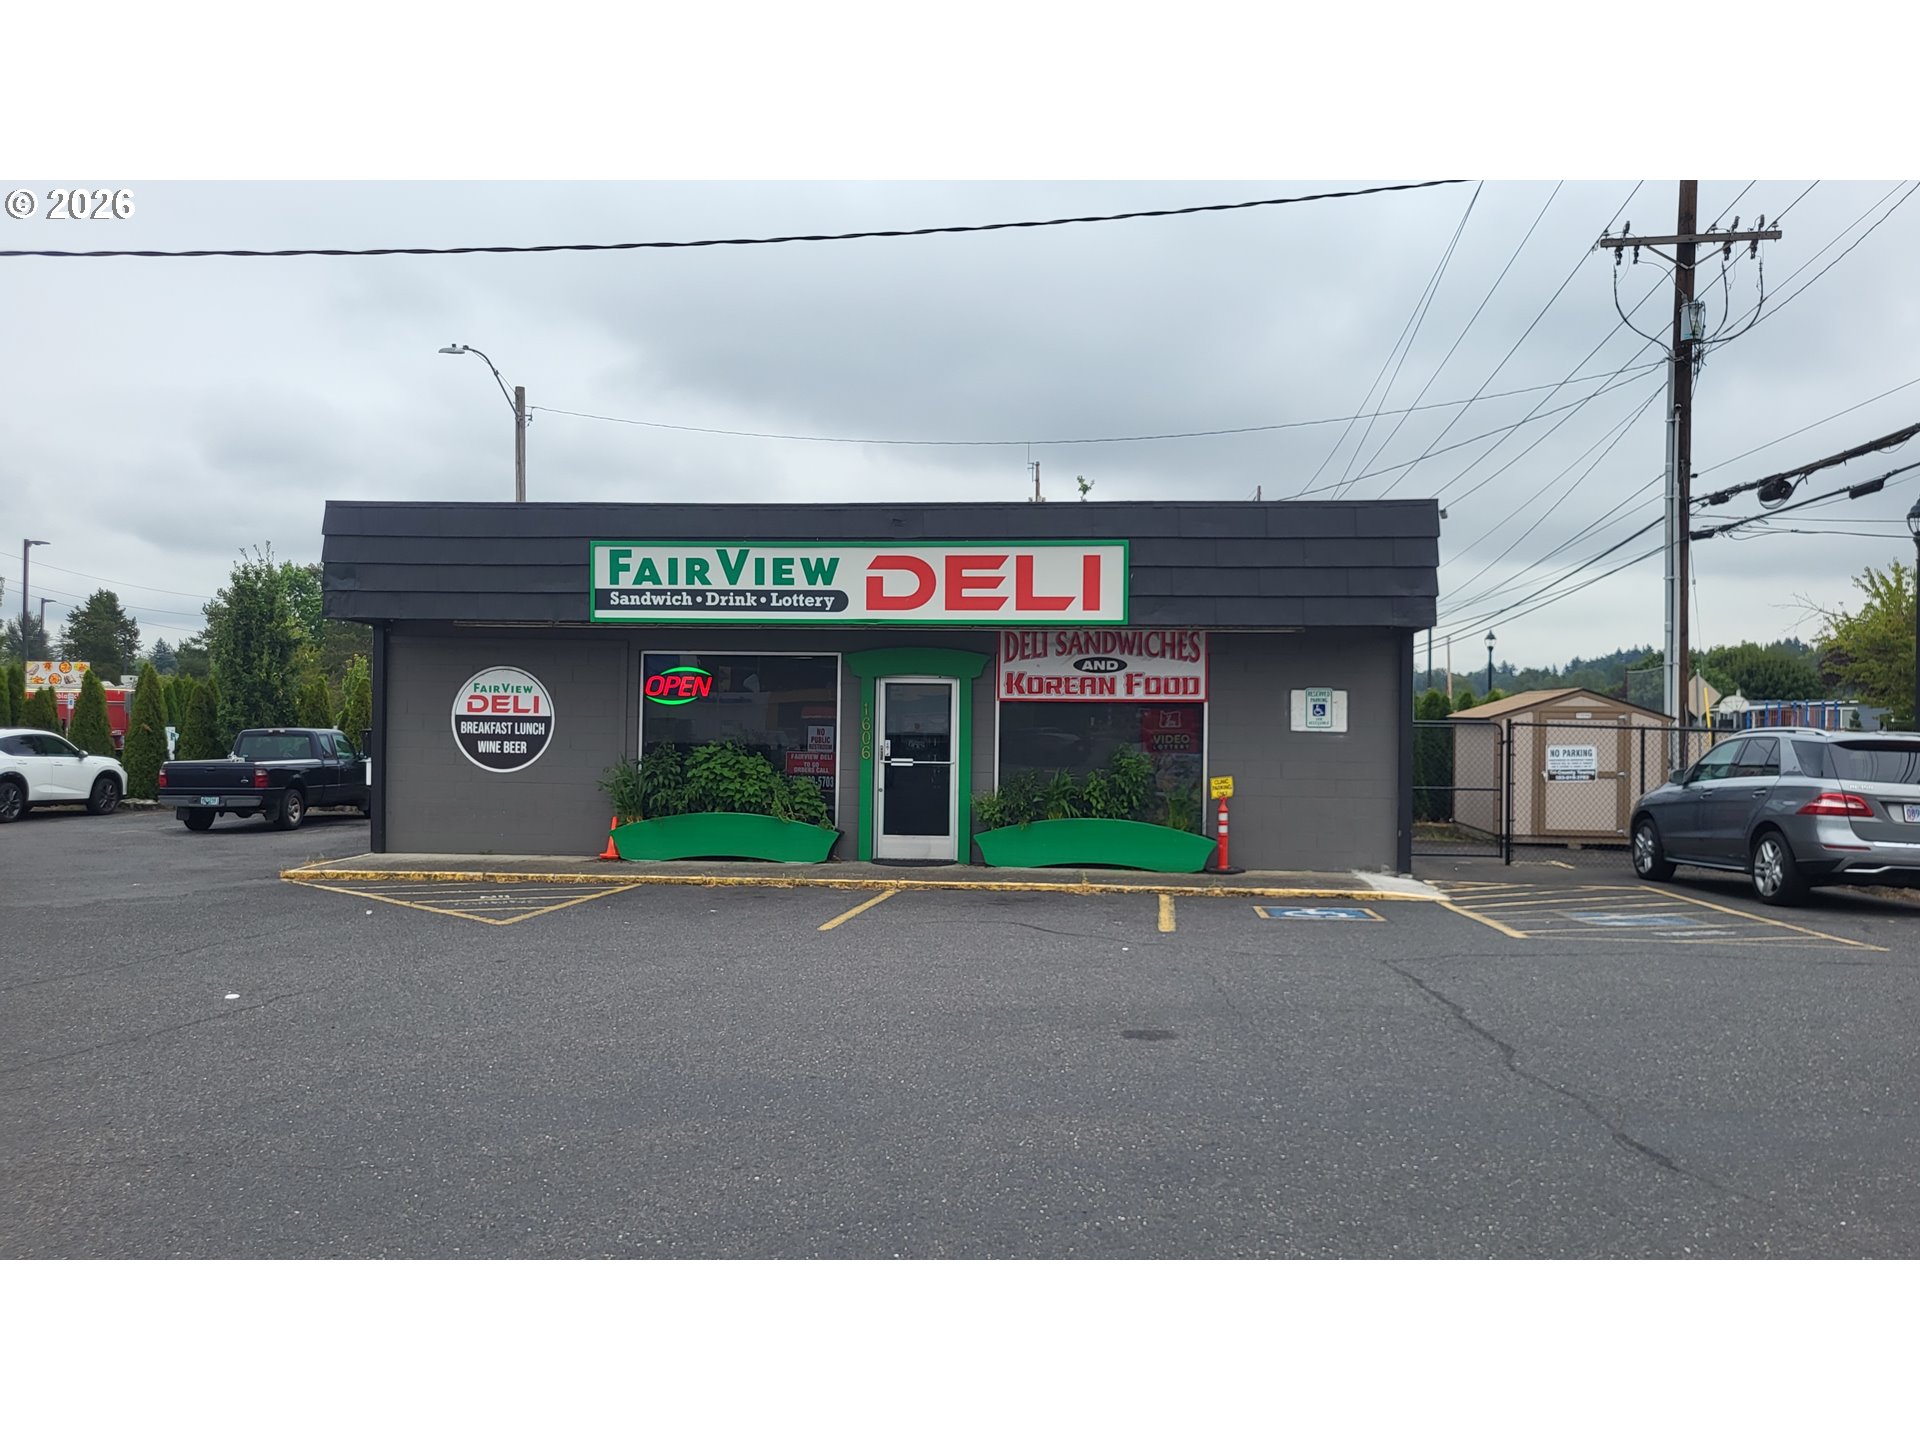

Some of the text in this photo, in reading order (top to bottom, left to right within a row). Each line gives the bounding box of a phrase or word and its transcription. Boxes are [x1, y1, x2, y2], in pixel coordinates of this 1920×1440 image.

[609, 549, 840, 585] FAIRVIEW
[866, 555, 1100, 611] DELI
[610, 591, 835, 610] Sandwich Drink Lottery
[1004, 631, 1200, 664] DELI SANDWICHES
[1081, 660, 1119, 671] AND
[473, 683, 533, 693] FAIRVIEW
[645, 676, 713, 697] OPEN
[1004, 671, 1201, 696] KOREAN FOOD
[467, 695, 539, 713] DELI
[460, 721, 545, 735] BREAKFAST LUNCH
[816, 728, 826, 736] NO
[862, 703, 870, 759] 1606
[477, 740, 527, 753] WINE BEER
[1153, 735, 1190, 744] VIDEO
[1549, 749, 1593, 757] NO PARKING
